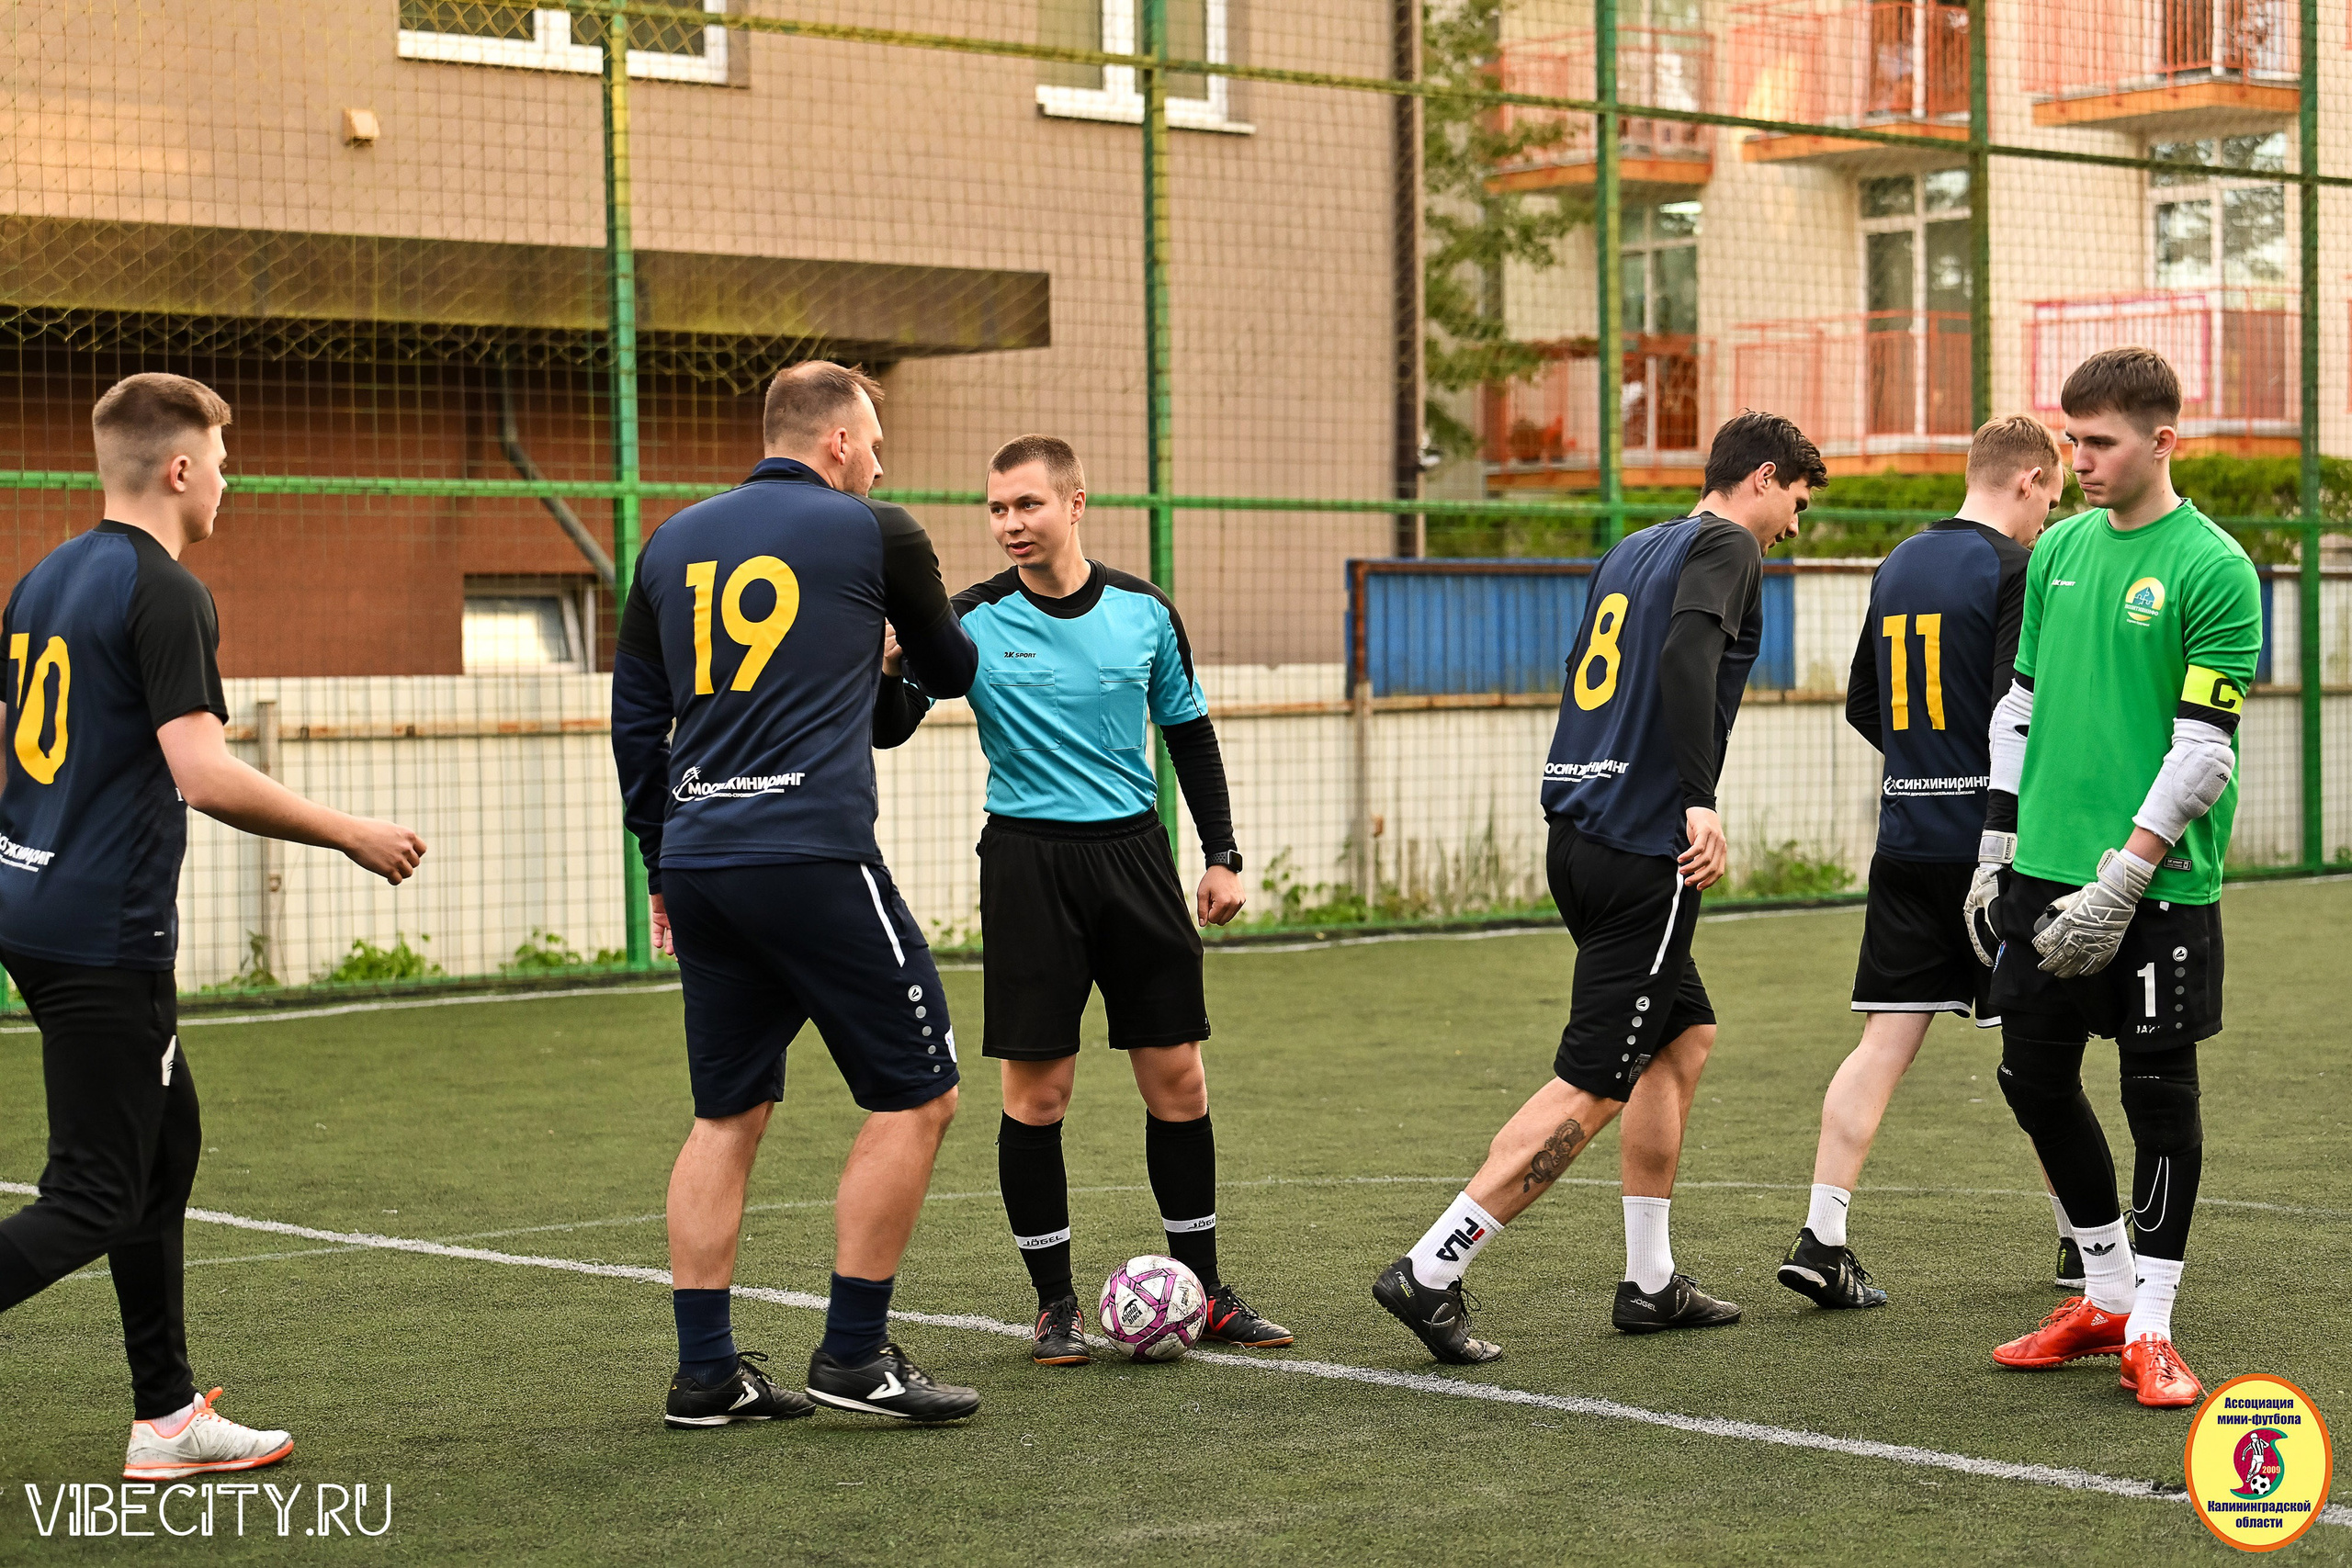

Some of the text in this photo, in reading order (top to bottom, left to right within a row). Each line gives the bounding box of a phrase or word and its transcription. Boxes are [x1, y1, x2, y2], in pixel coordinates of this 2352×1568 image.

[685, 555, 800, 695] 19
[1574, 592, 1629, 711] 8
[1883, 613, 1946, 731] 11
[9, 632, 72, 785] 10
[2210, 677, 2237, 709] C
[2137, 962, 2157, 1018] 1
[1023, 1235, 1064, 1247] JÖGEL
[1187, 1218, 1216, 1230] JÖGE
[1435, 1216, 1486, 1262] FILA
[1630, 1296, 1657, 1313] JÖGEL
